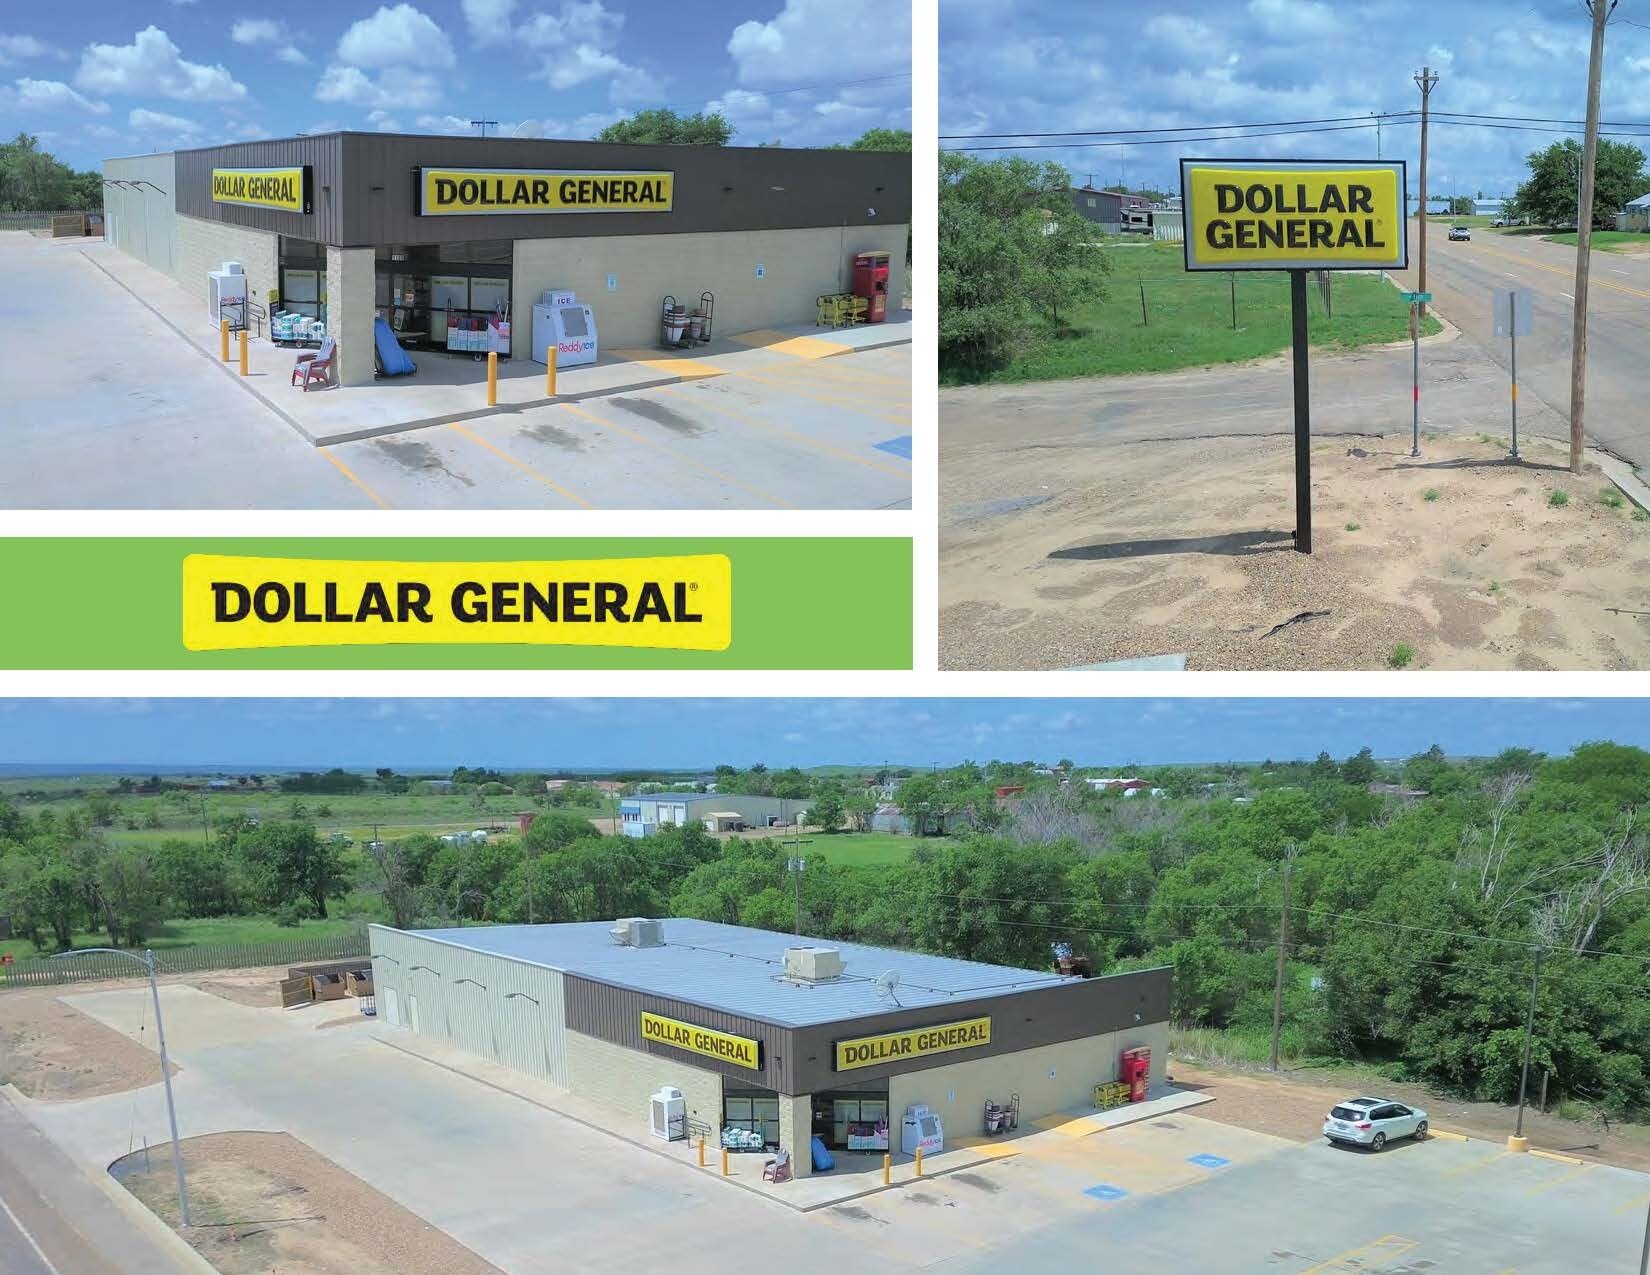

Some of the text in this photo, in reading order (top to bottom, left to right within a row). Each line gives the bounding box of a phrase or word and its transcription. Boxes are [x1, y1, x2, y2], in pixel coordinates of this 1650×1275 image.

[214, 175, 297, 202] DOLLAR GENERAL
[434, 178, 667, 205] DOLLAR GENERAL
[1213, 183, 1374, 214] DOLLAR
[1205, 218, 1386, 249] GENERAL
[557, 297, 571, 305] ICE
[644, 1018, 752, 1063] DOLLAR GENERAL
[844, 1023, 987, 1065] DOLLAR GENERAL
